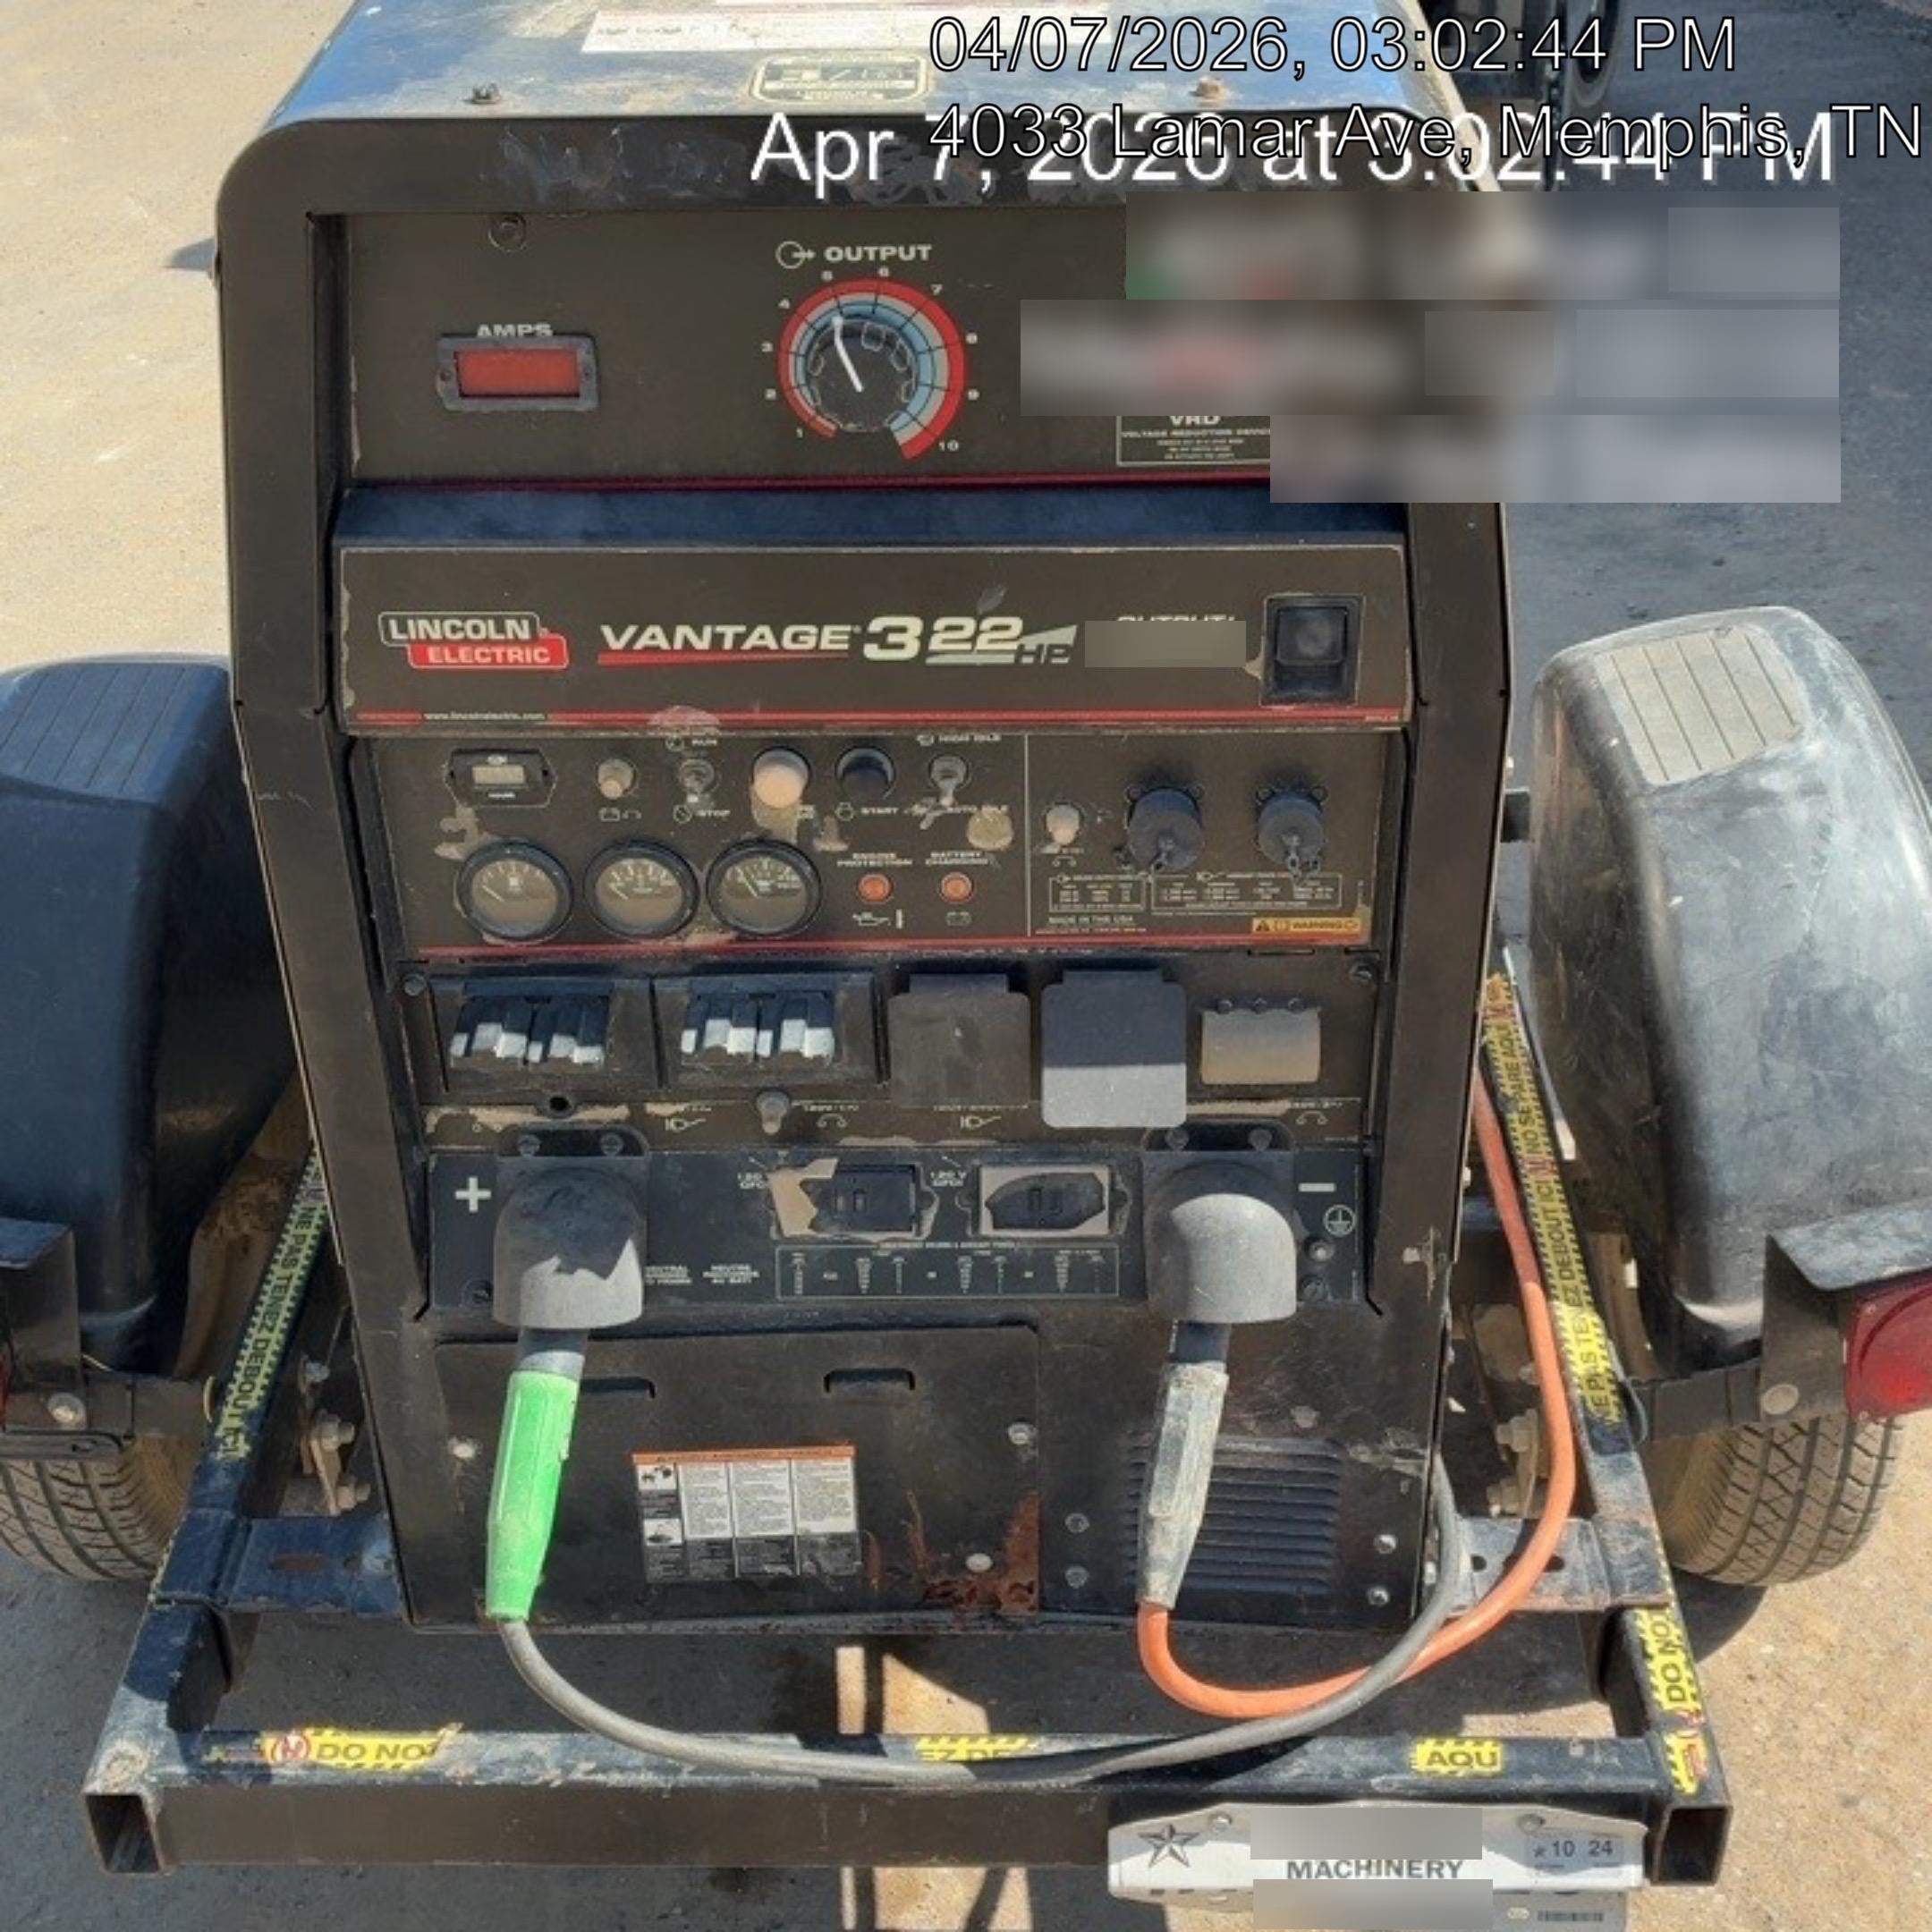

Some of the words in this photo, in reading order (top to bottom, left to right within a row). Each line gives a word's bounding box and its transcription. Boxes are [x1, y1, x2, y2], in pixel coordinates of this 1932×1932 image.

[825, 244, 932, 262] OUTPUT
[477, 322, 554, 337] AMPS
[387, 618, 531, 640] LINCOLN
[600, 624, 852, 651] VANTAGE
[863, 615, 1023, 661] 322
[428, 645, 551, 664] ELECTRIC
[1661, 1662, 1687, 1702] DO
[316, 1743, 368, 1761] DO
[374, 1743, 433, 1761] NO
[1552, 1840, 1576, 1859] 10
[1589, 1839, 1614, 1857] 24
[1287, 1860, 1464, 1879] MACHINERY
